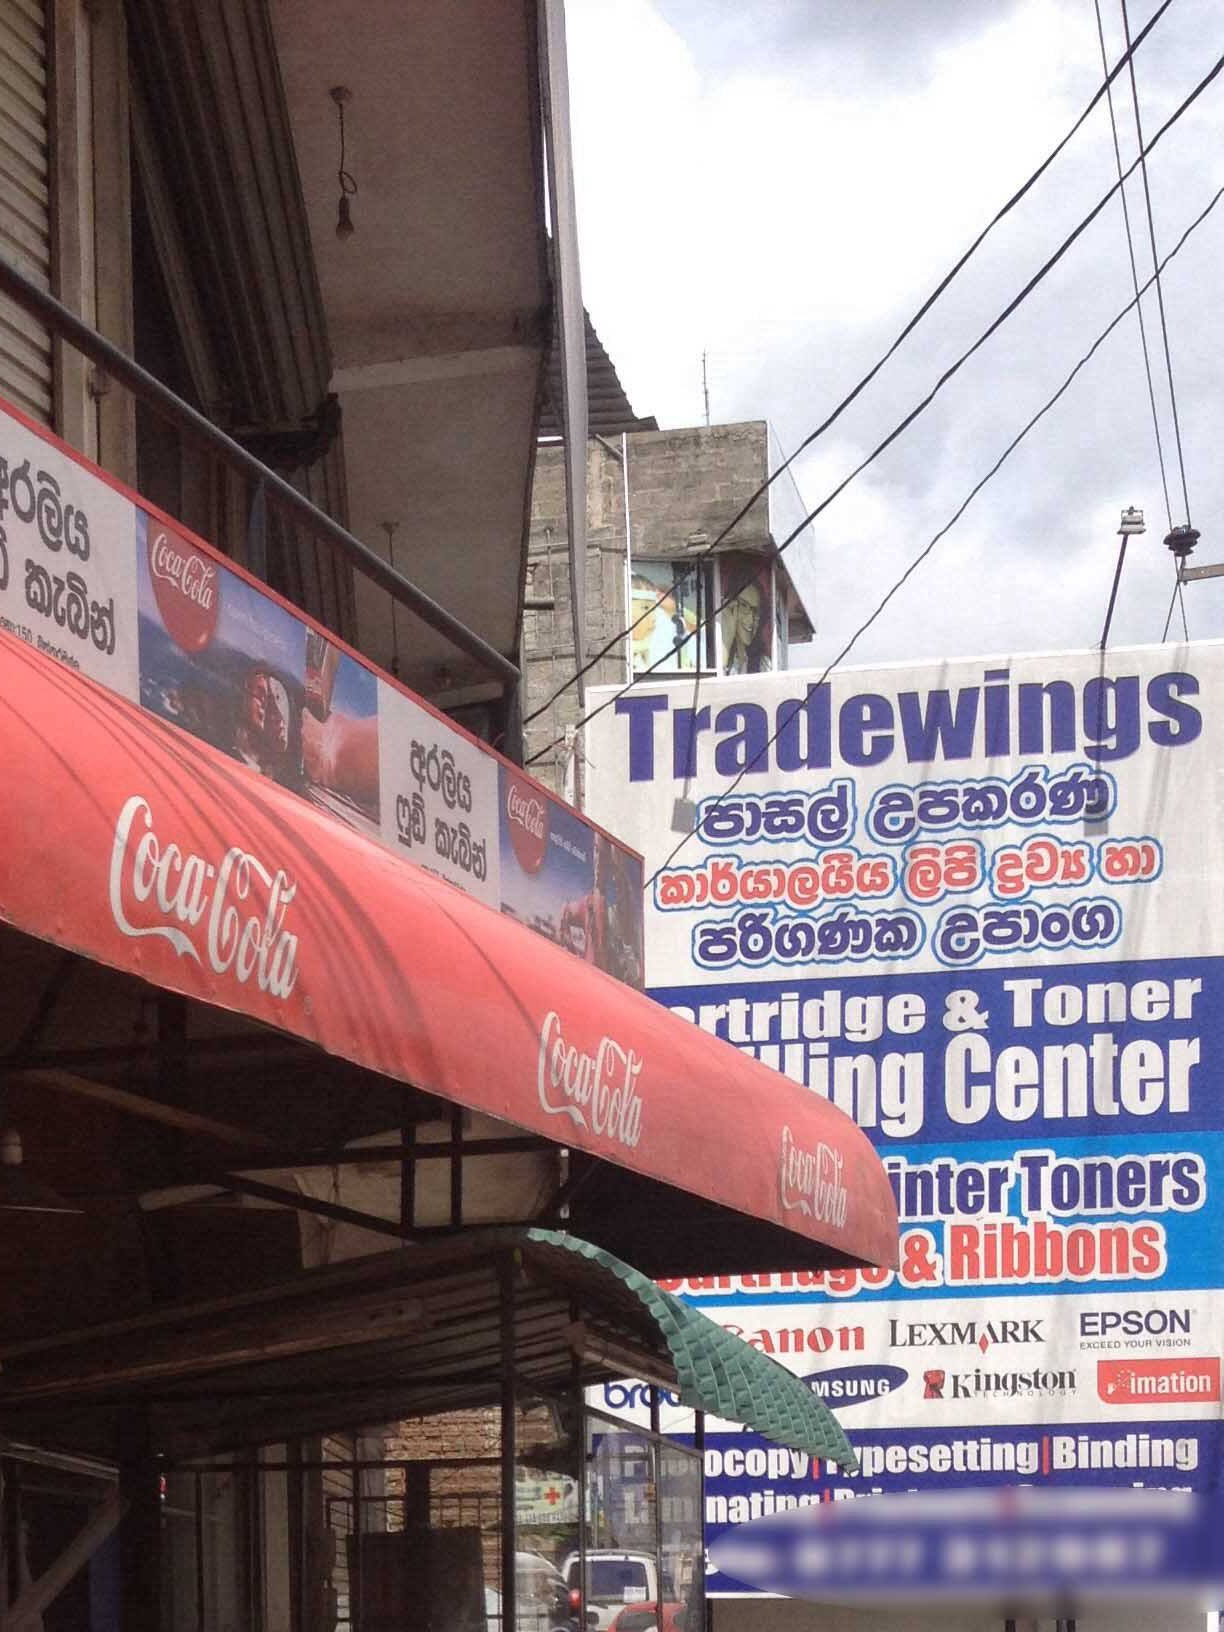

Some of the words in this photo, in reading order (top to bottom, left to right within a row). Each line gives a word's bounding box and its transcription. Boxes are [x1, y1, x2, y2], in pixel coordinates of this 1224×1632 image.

[151, 532, 216, 609] Coca-Cola
[25, 558, 115, 655] කැබින්
[615, 670, 1203, 782] Tradewings
[410, 740, 472, 813] අරලිය
[703, 784, 849, 842] පාසල්
[873, 772, 1108, 839] උපකරණ
[507, 784, 545, 840] Coca-Cola
[110, 795, 299, 1000] Coca-Cola
[908, 845, 978, 898] ලිපි
[1104, 844, 1156, 878] හා
[698, 911, 918, 962] පරිගණක
[940, 903, 1115, 960] උපාංග
[668, 989, 926, 1042] rtridge
[942, 988, 990, 1030] &
[1004, 977, 1202, 1028] Toner
[537, 1010, 644, 1148] Coca-Cola
[945, 1034, 1200, 1125] Center
[781, 1124, 849, 1231] Coca-Cola
[887, 1163, 1010, 1218] inter
[1021, 1152, 1200, 1212] Toners
[902, 1235, 938, 1283] &
[950, 1221, 1161, 1281] Ribbons
[888, 1319, 1046, 1353] LEXMARK
[1079, 1309, 1191, 1336] EPSON
[811, 1378, 891, 1399] MSUNG
[951, 1368, 1077, 1401] Kingston
[1130, 1371, 1211, 1394] imation
[624, 1445, 808, 1479] ocopy
[827, 1437, 1039, 1479] pesetting
[1052, 1434, 1198, 1472] Binding
